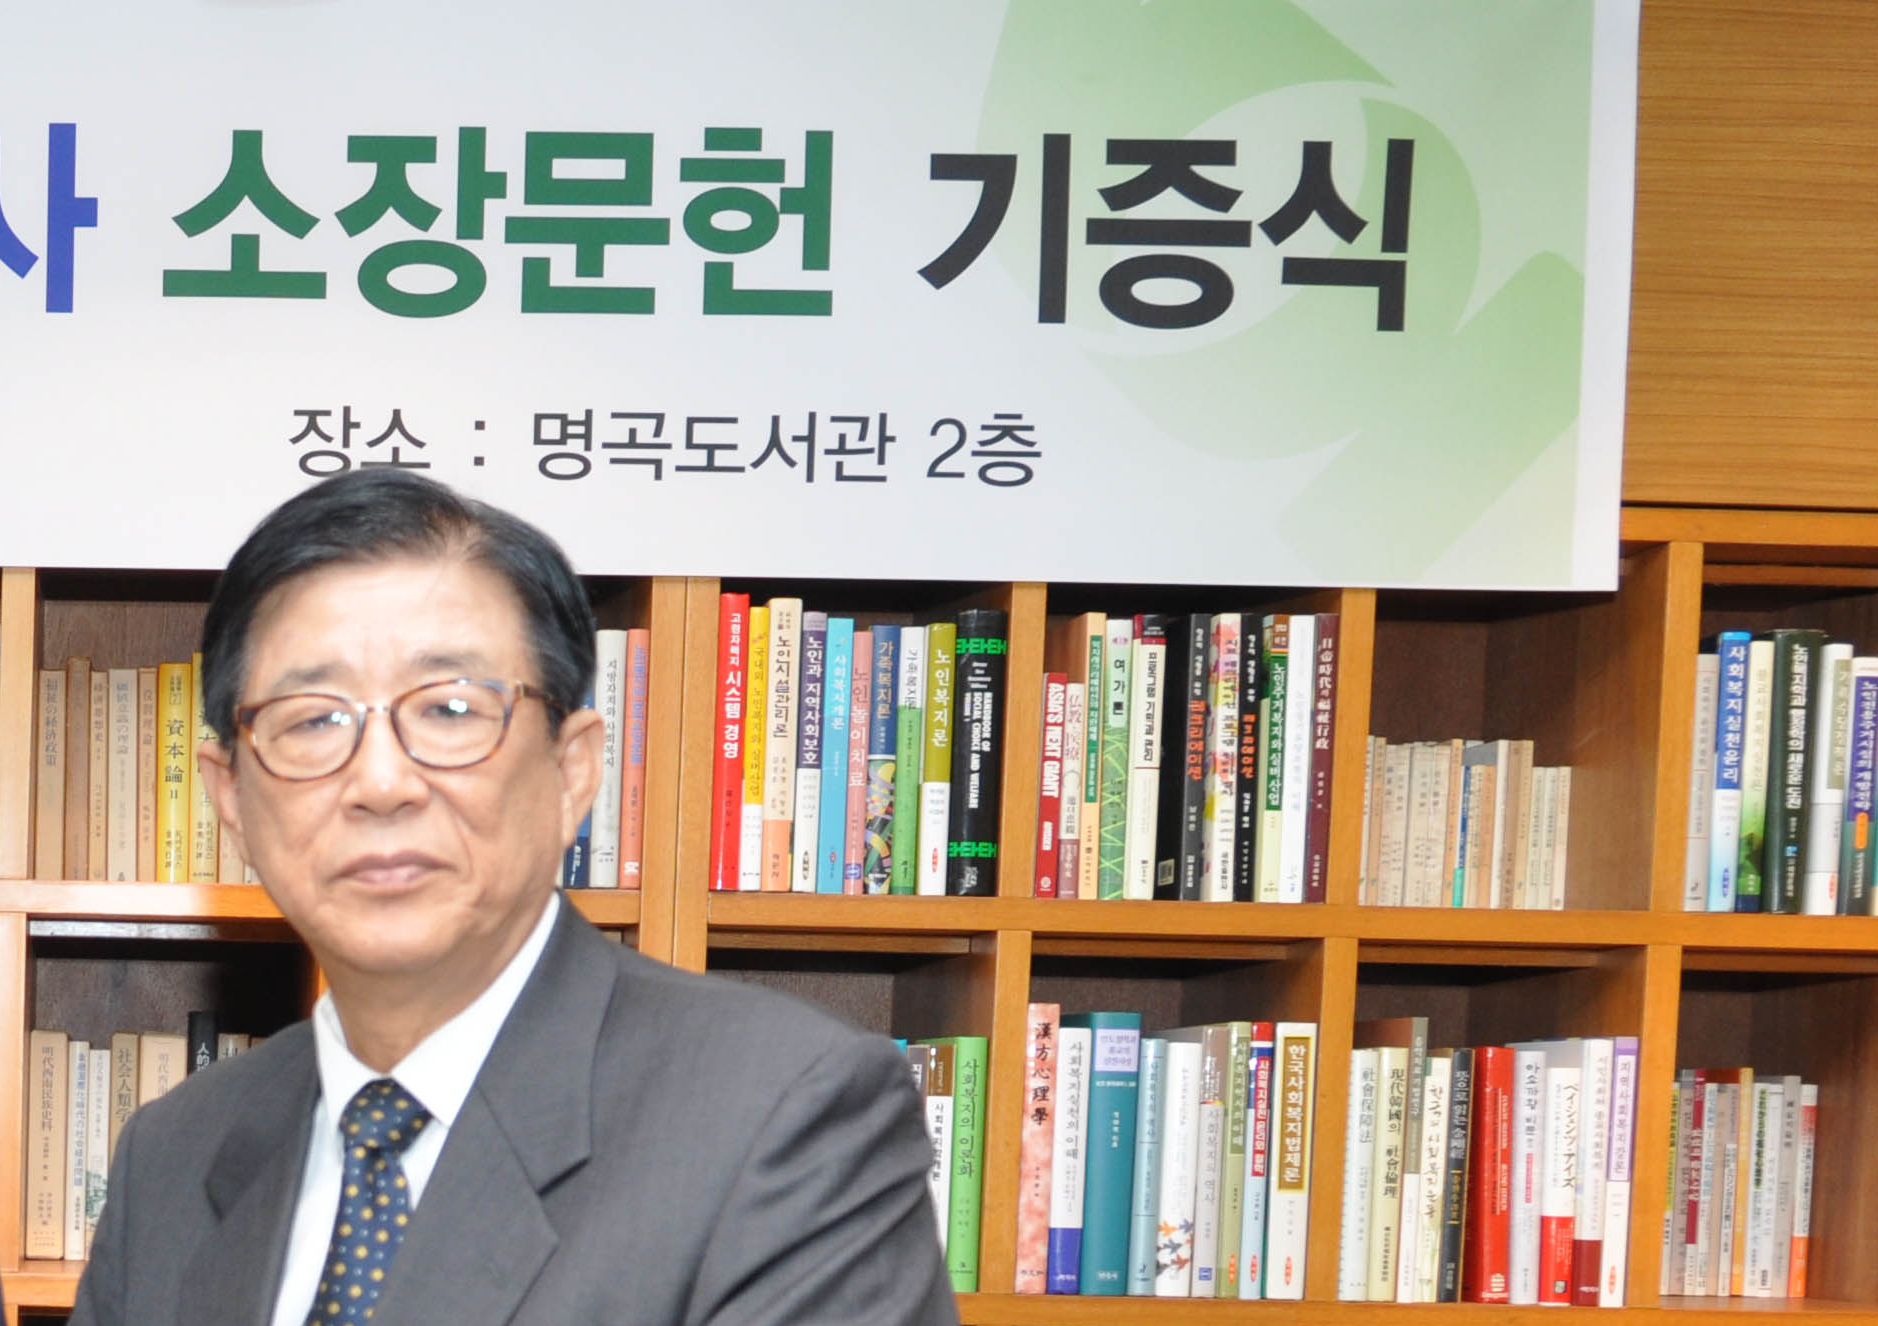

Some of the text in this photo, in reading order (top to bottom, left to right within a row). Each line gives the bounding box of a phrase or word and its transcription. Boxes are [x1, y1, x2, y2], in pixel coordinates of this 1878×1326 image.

[163, 127, 833, 318] 소장문헌
[918, 134, 1416, 331] 기증식
[290, 406, 430, 478] 장소
[534, 409, 896, 483] 명곡도서관
[927, 414, 1041, 487] 2층
[725, 672, 742, 719] 시스템
[806, 637, 823, 677] 노인과
[876, 641, 894, 720] 가족복지론
[849, 667, 869, 787] 노인놀이치료
[930, 649, 952, 748] 노인복지론
[165, 719, 185, 784] 資本論
[723, 724, 740, 758] 경영
[197, 1042, 210, 1072] 人的
[1031, 1021, 1053, 1126] 漢方心理學
[1282, 1043, 1307, 1184] 한국사회복지법제론
